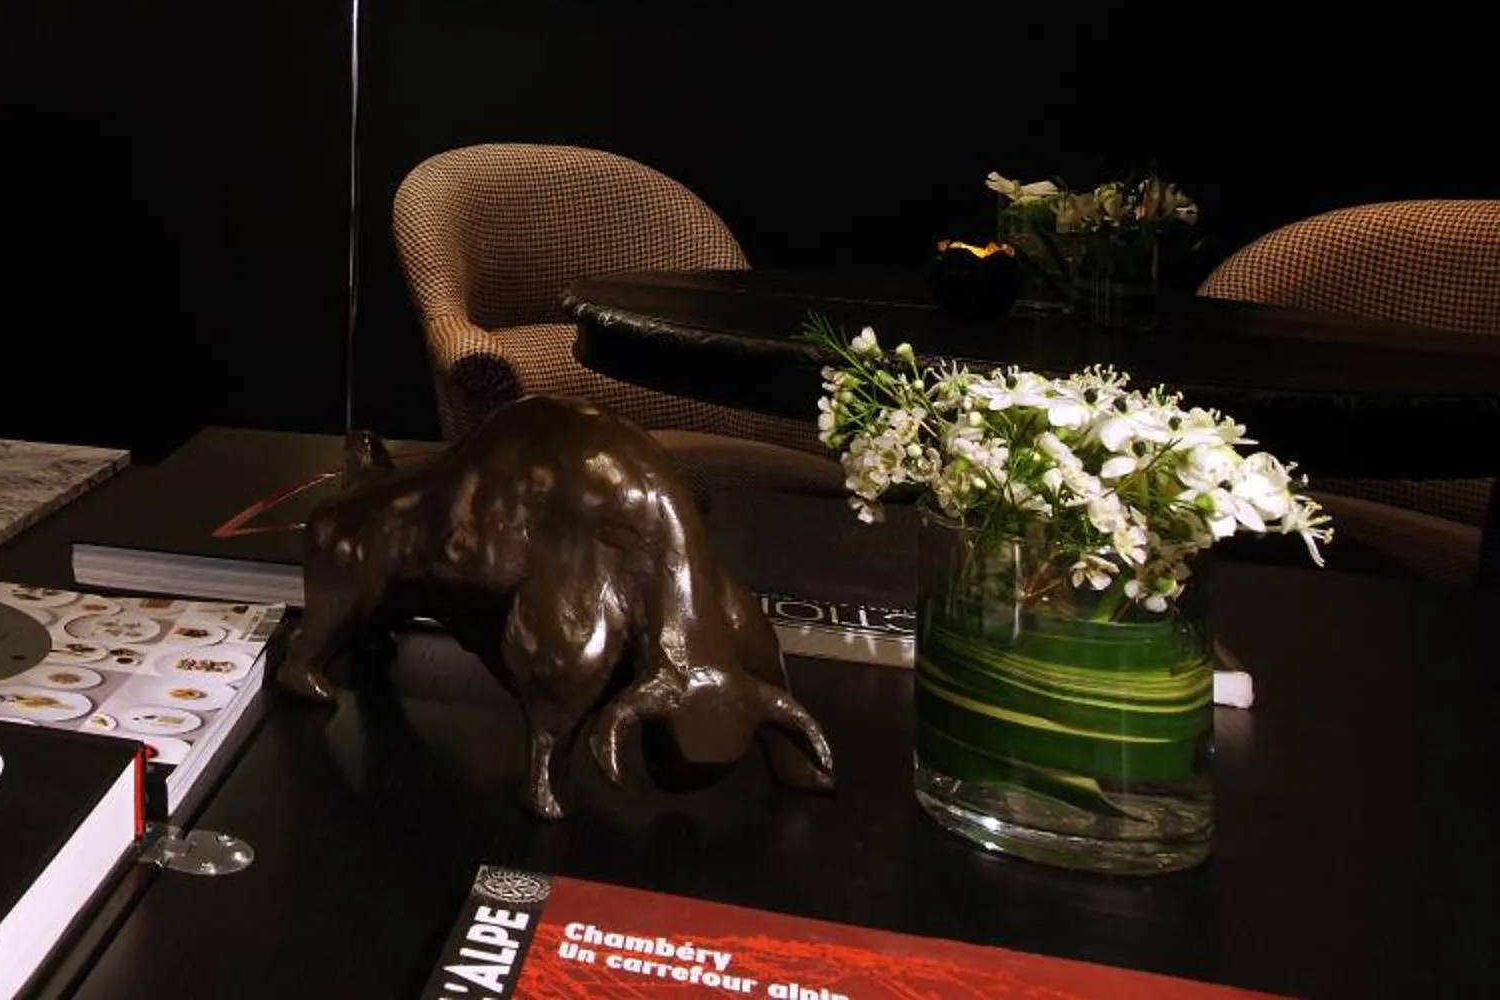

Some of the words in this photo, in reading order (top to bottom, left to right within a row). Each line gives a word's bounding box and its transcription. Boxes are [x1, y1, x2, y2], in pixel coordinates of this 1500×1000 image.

[437, 905, 530, 1000] 'ALPE
[558, 940, 596, 965] Un
[605, 954, 759, 994] carrefour
[564, 922, 732, 972] Chambéry
